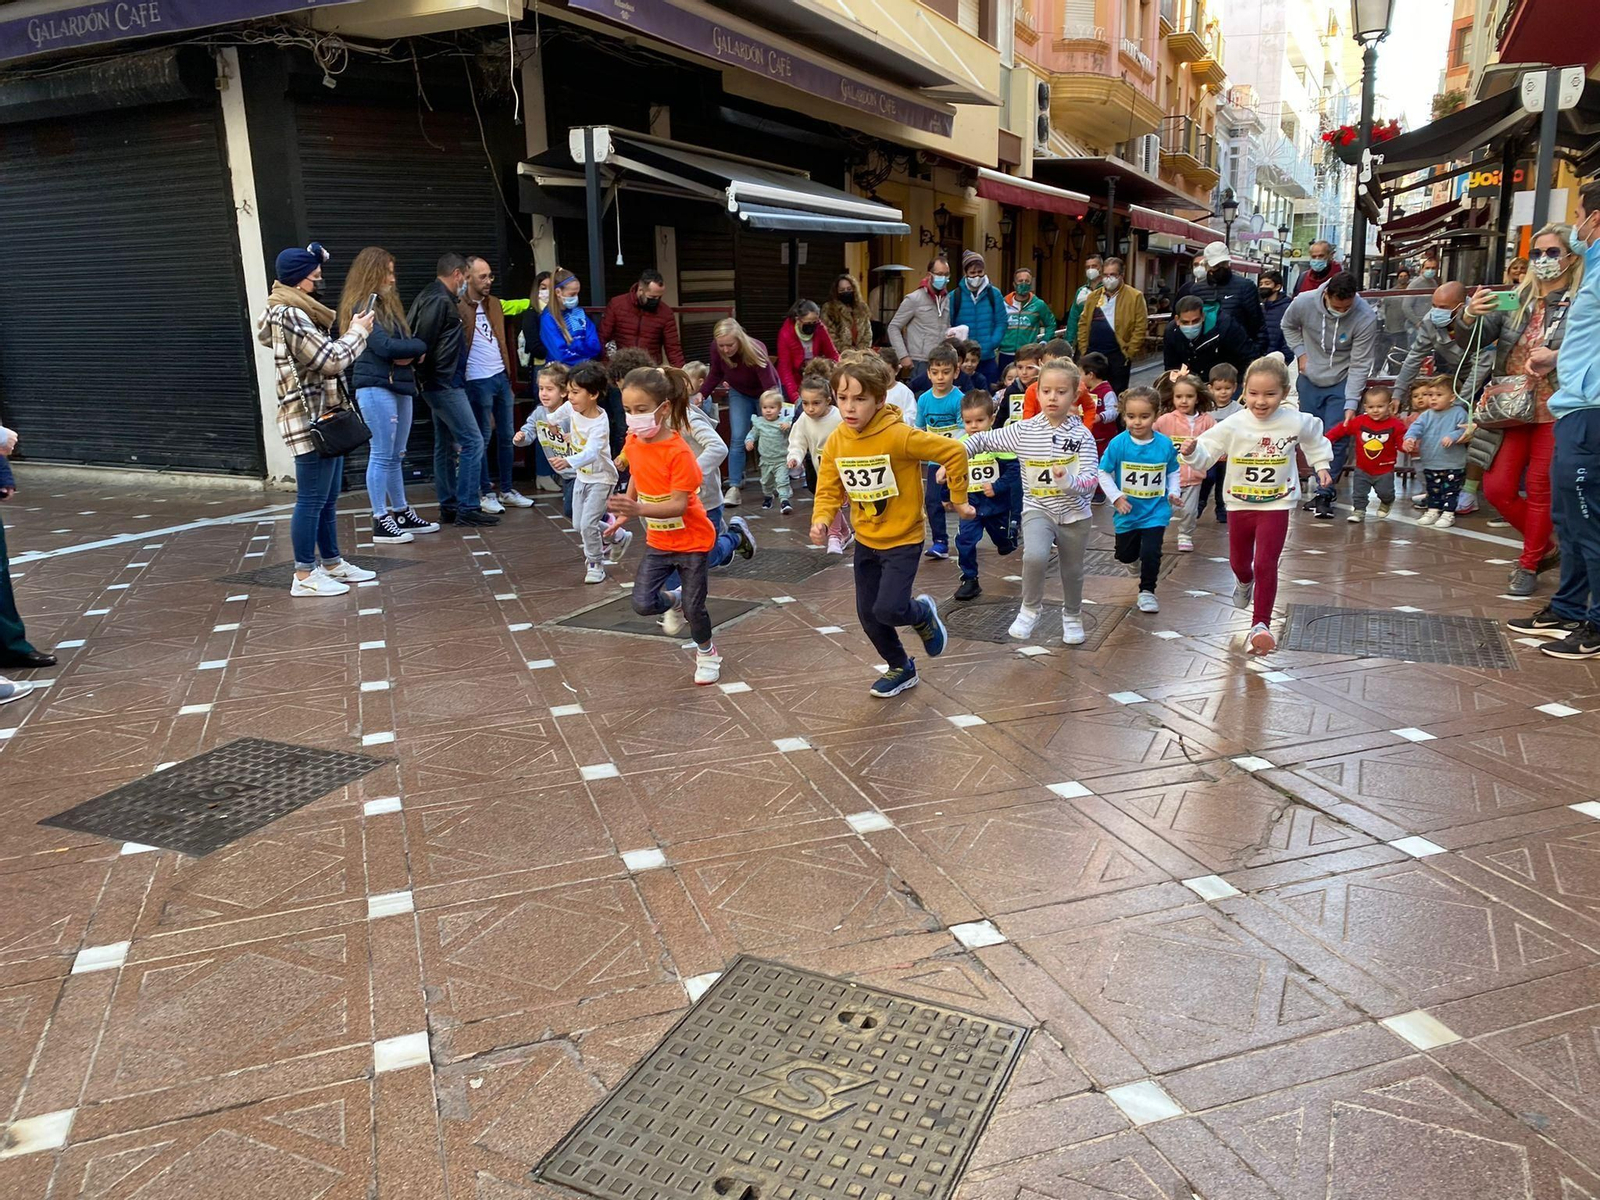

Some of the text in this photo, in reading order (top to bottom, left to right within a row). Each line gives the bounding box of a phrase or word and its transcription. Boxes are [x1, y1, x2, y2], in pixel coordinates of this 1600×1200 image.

[1469, 168, 1525, 189] yoio
[843, 466, 887, 487] 337
[971, 466, 995, 481] 69
[1125, 471, 1162, 487] 414
[1245, 466, 1276, 483] 52
[772, 1066, 841, 1110] S
